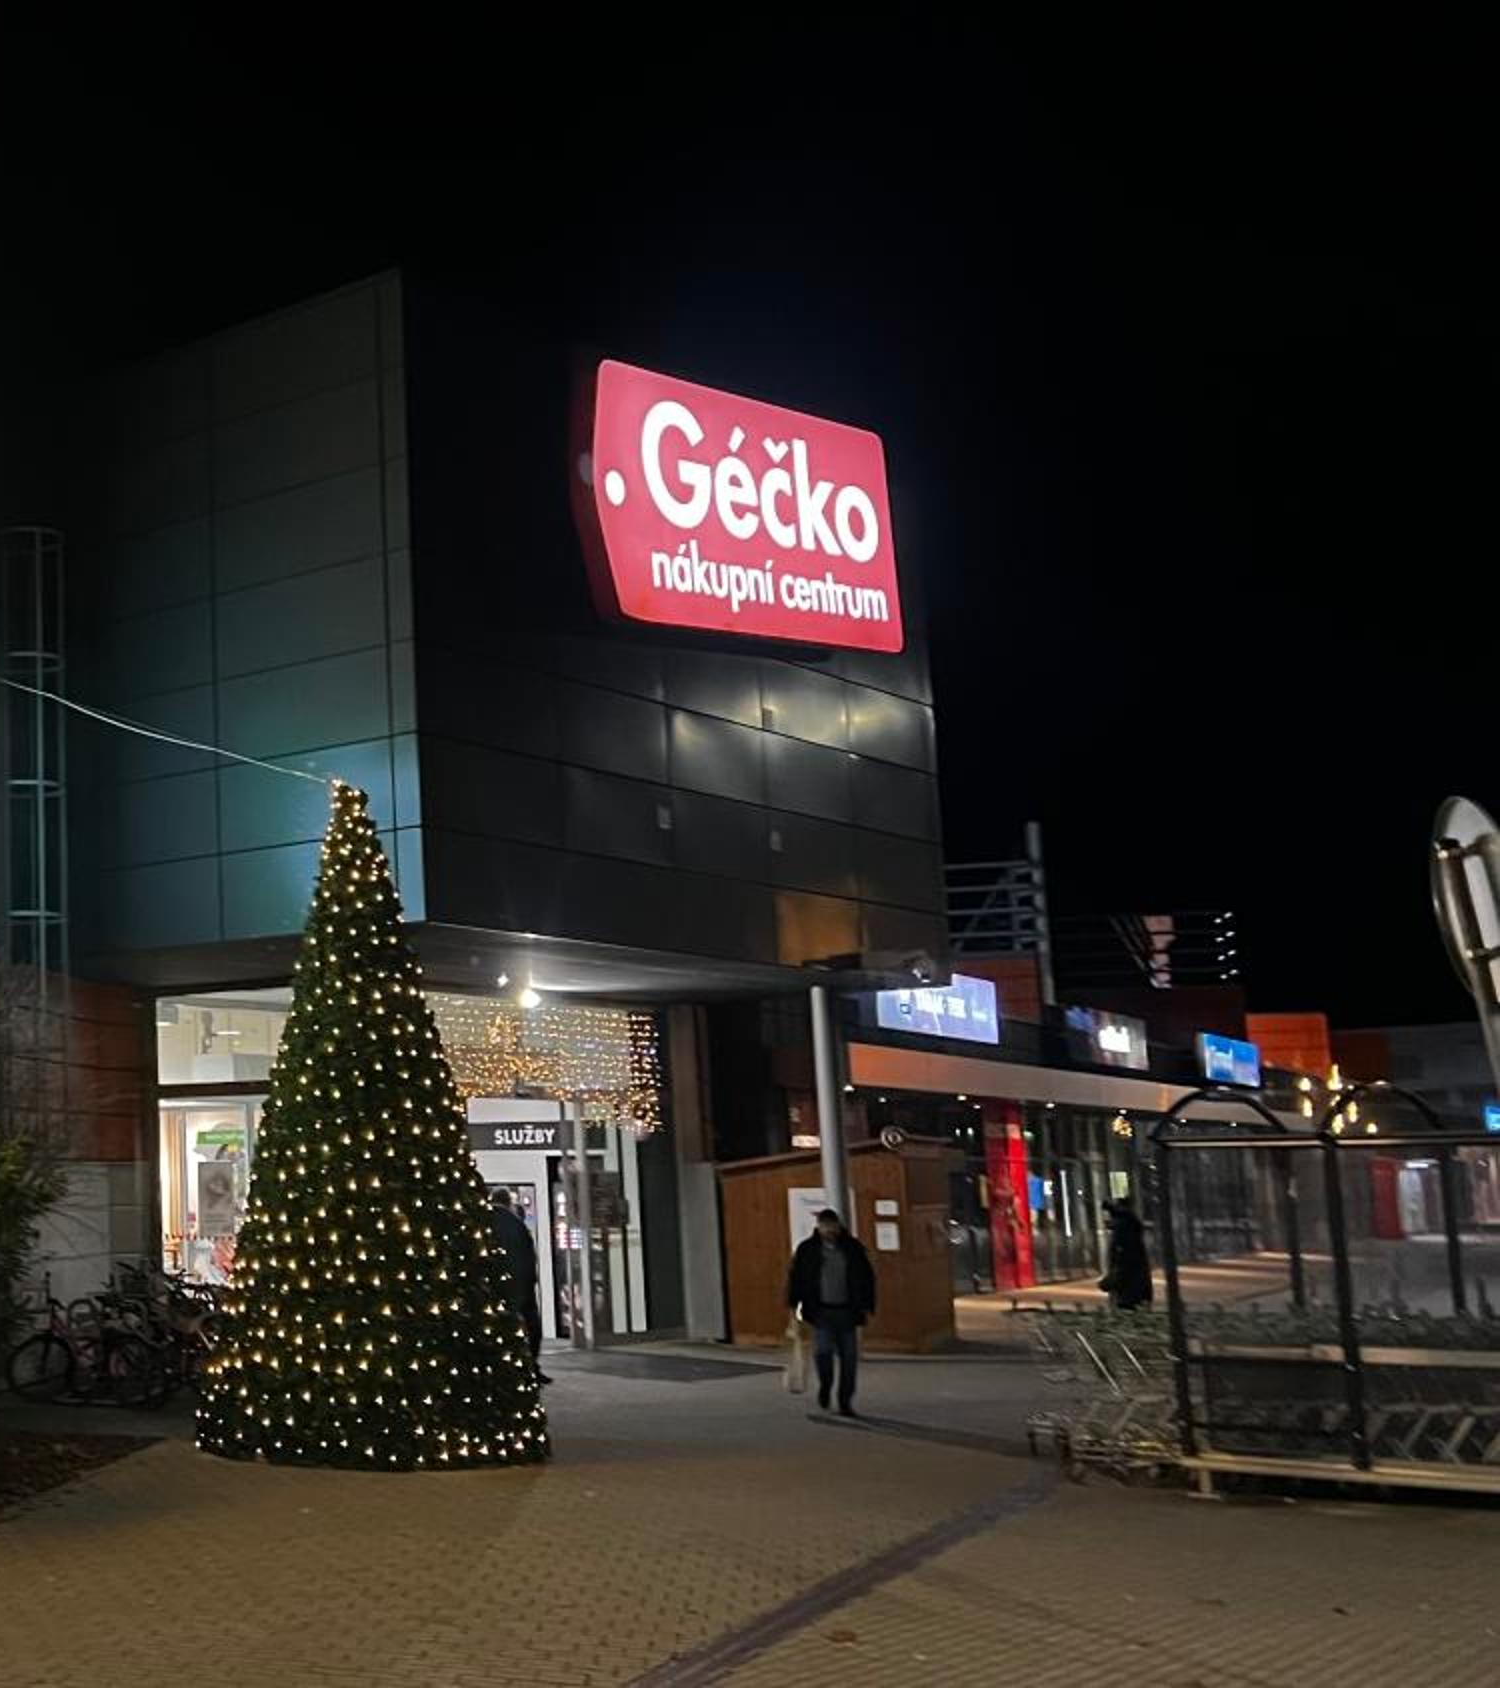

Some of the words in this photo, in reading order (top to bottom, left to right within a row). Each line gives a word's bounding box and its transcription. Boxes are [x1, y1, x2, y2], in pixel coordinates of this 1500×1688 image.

[641, 400, 879, 563] Géčko
[651, 539, 775, 613] nákupní
[780, 572, 889, 622] centrum
[494, 1124, 556, 1145] SLUŽBY
